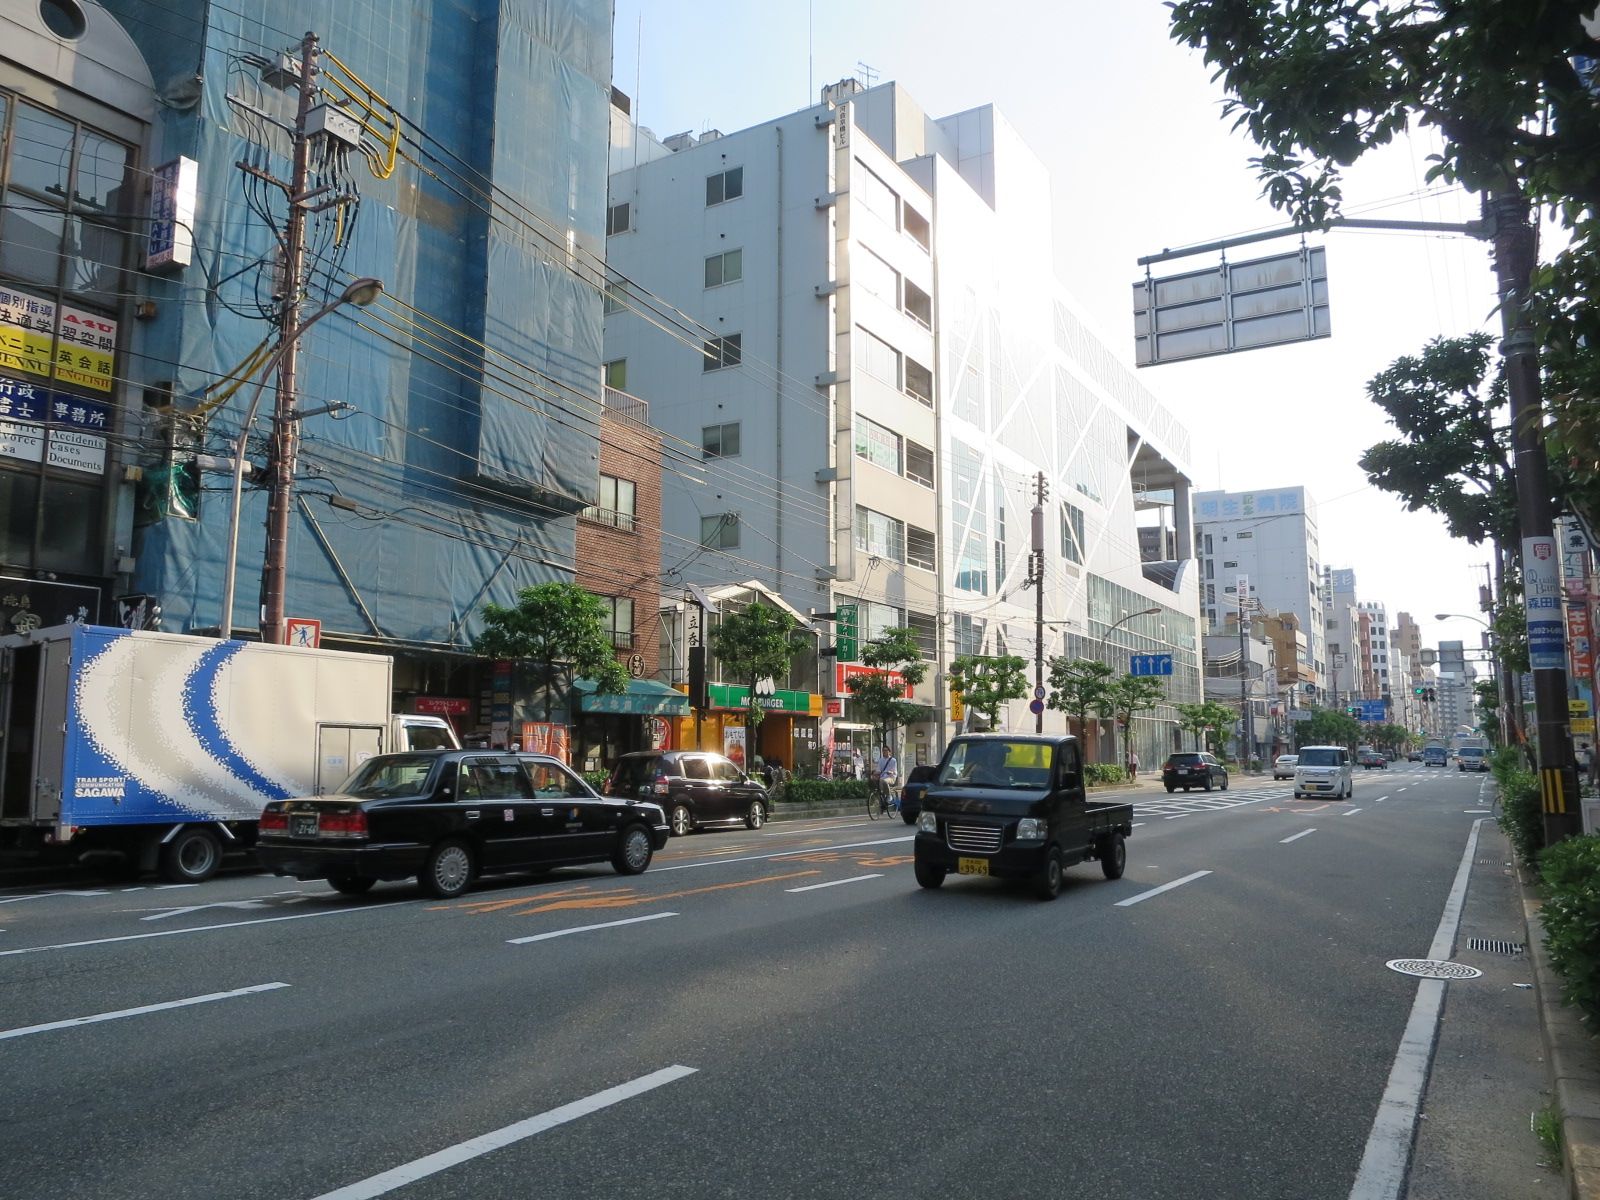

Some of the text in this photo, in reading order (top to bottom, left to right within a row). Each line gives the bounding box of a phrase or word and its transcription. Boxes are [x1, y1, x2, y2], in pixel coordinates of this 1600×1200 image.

[59, 350, 111, 375] 英会話
[57, 366, 109, 388] ENGLISH
[53, 401, 105, 428] 事務所
[50, 441, 80, 456] Cases
[51, 430, 104, 449] Accidents
[50, 452, 102, 471] Documents
[75, 787, 125, 798] SAGAWA
